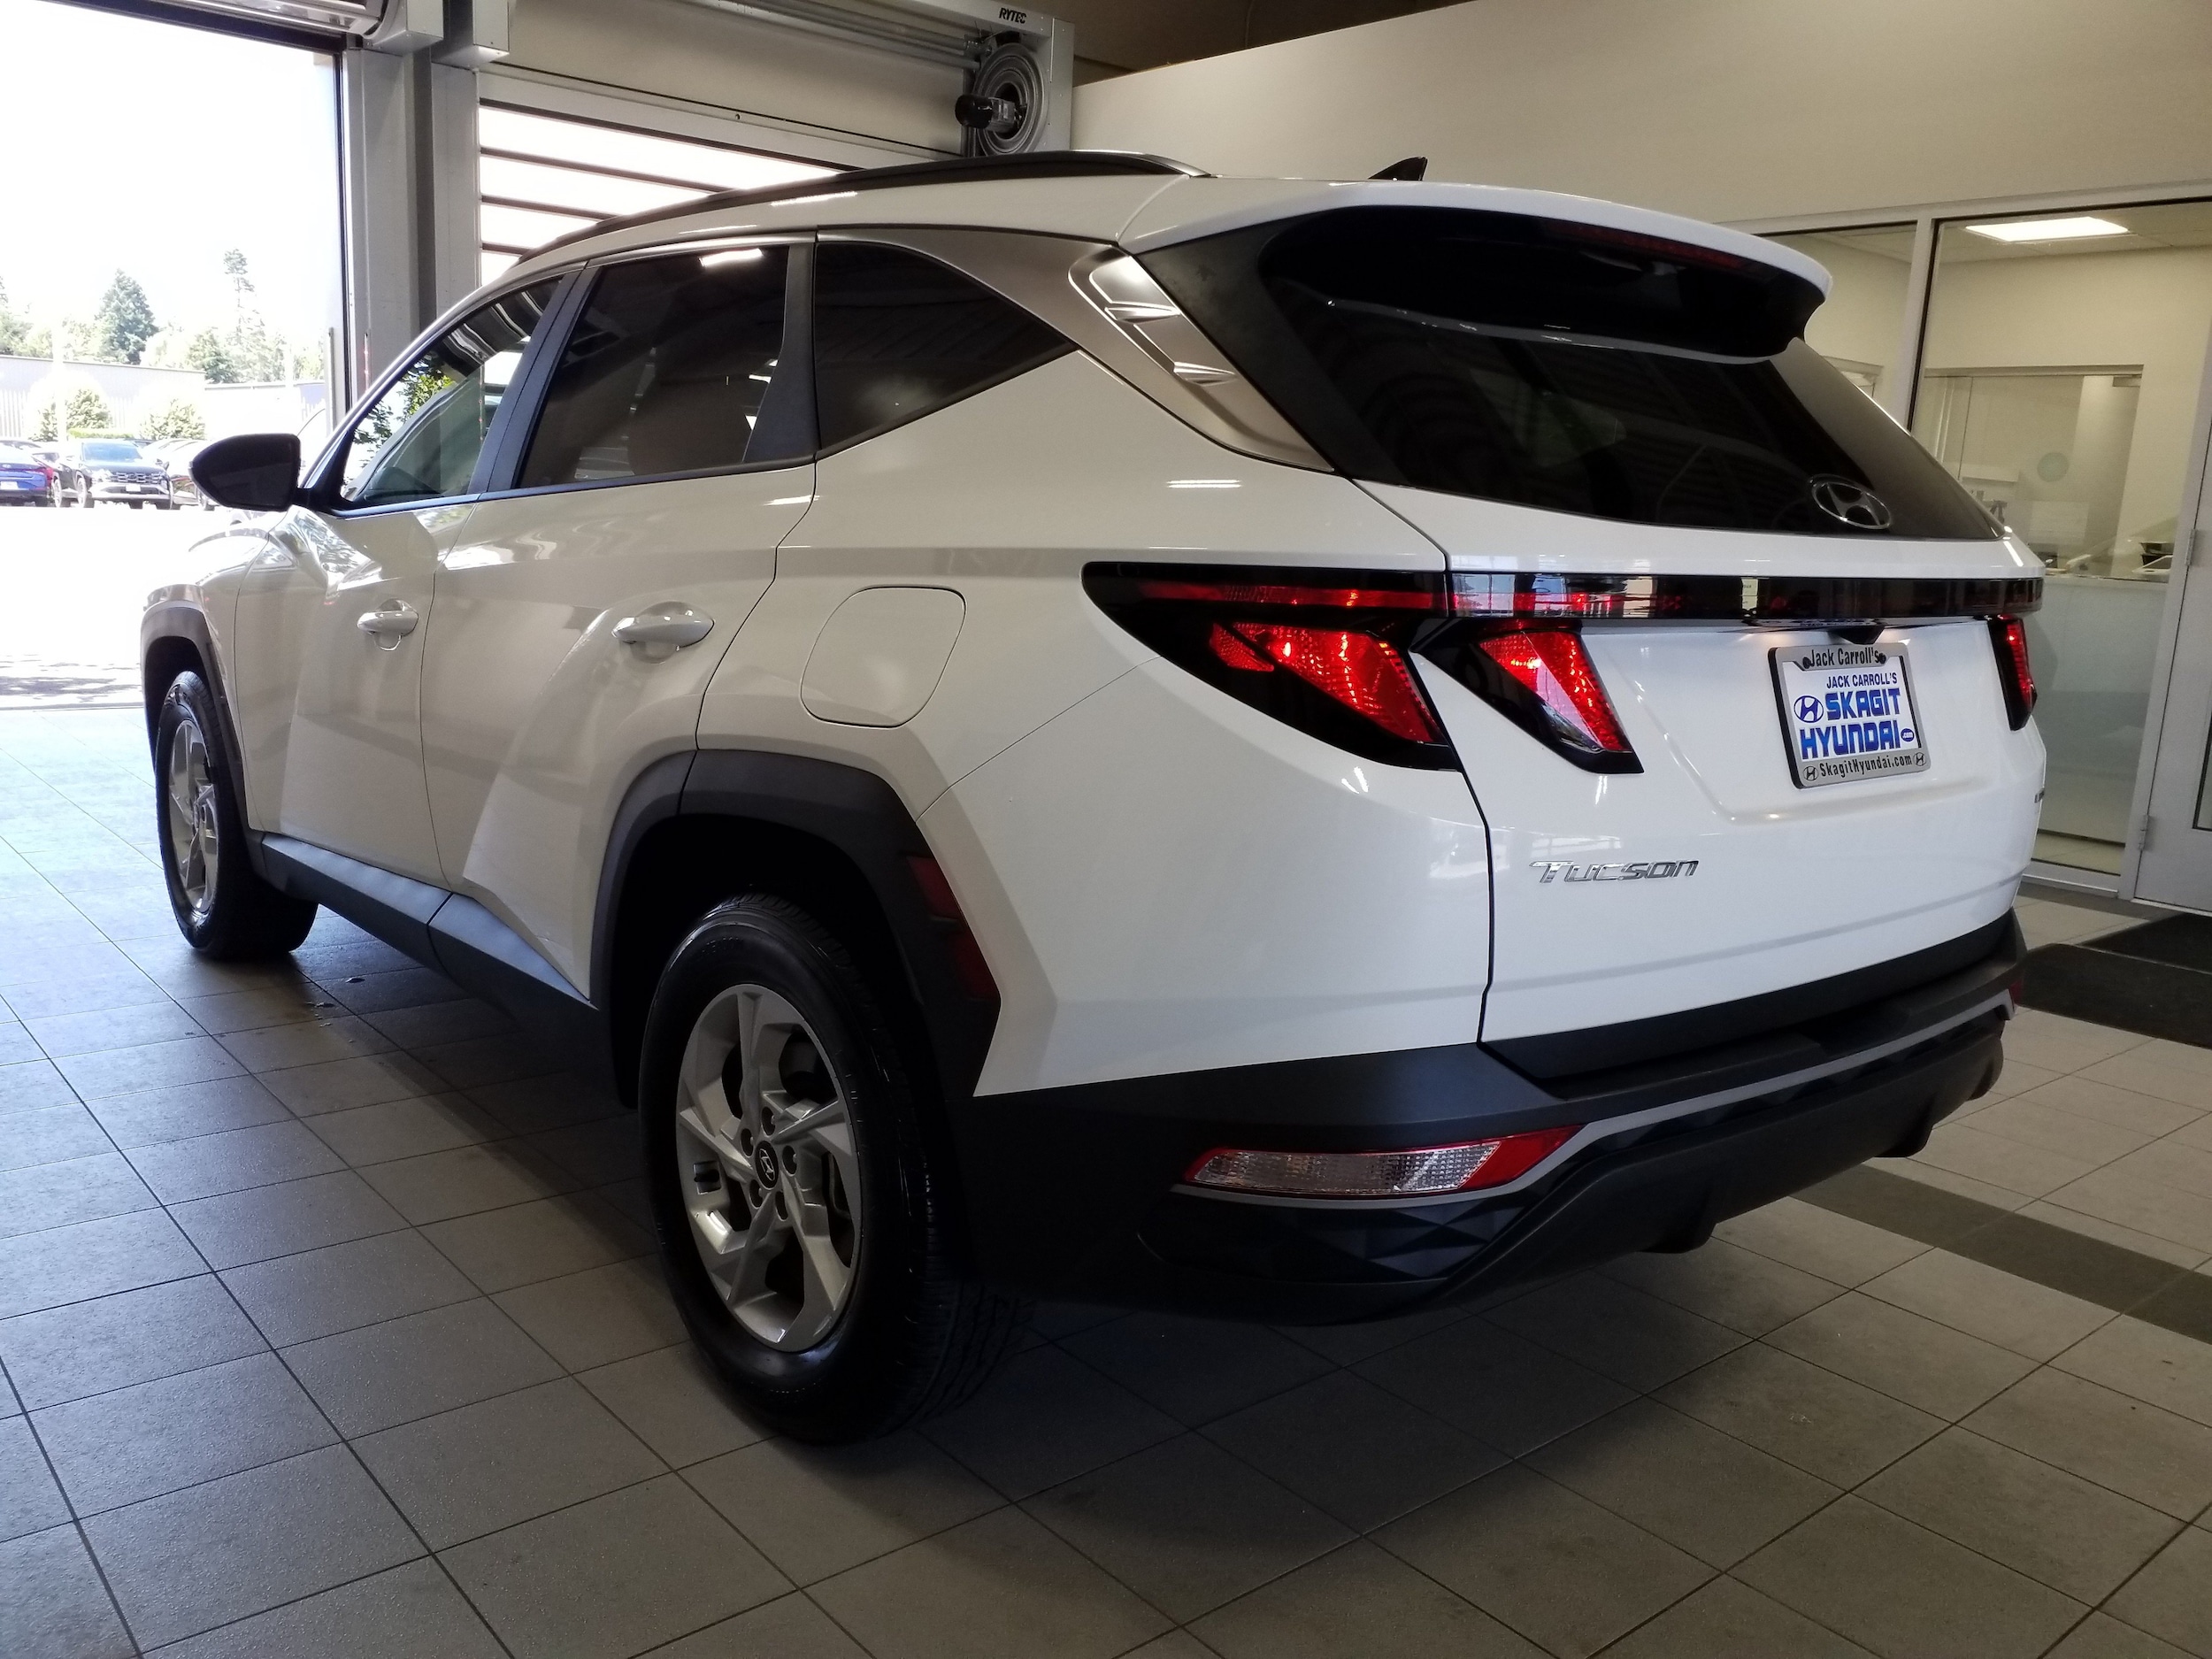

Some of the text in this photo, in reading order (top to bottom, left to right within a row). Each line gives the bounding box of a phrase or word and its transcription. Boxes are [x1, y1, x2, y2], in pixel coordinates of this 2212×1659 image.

[999, 7, 1027, 24] RYTEC
[1809, 647, 1880, 666] Jack Carroll's
[1826, 672, 1898, 688] JACK CARROLL'S
[1824, 687, 1901, 721] SKAGIT
[1799, 719, 1901, 760] HYUNDAI
[1819, 755, 1913, 778] SkagitHyundai.com
